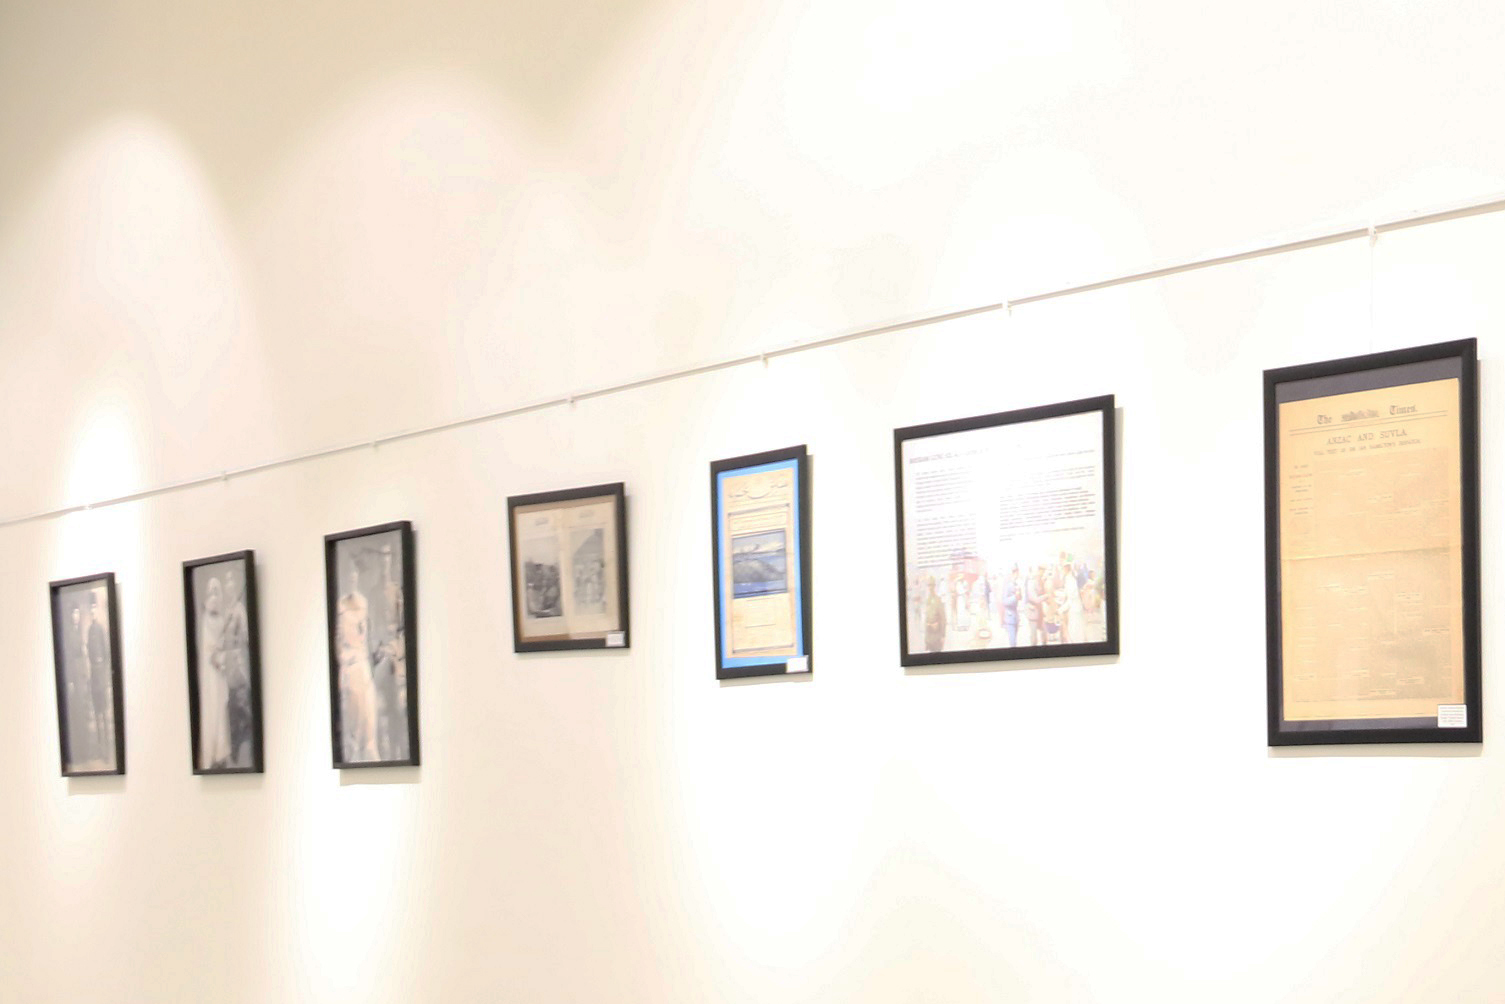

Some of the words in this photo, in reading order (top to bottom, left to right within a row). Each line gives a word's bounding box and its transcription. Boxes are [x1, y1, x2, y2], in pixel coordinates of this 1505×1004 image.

[1317, 414, 1332, 425] The
[1357, 432, 1374, 442] AND
[1380, 429, 1408, 440] SUVLA
